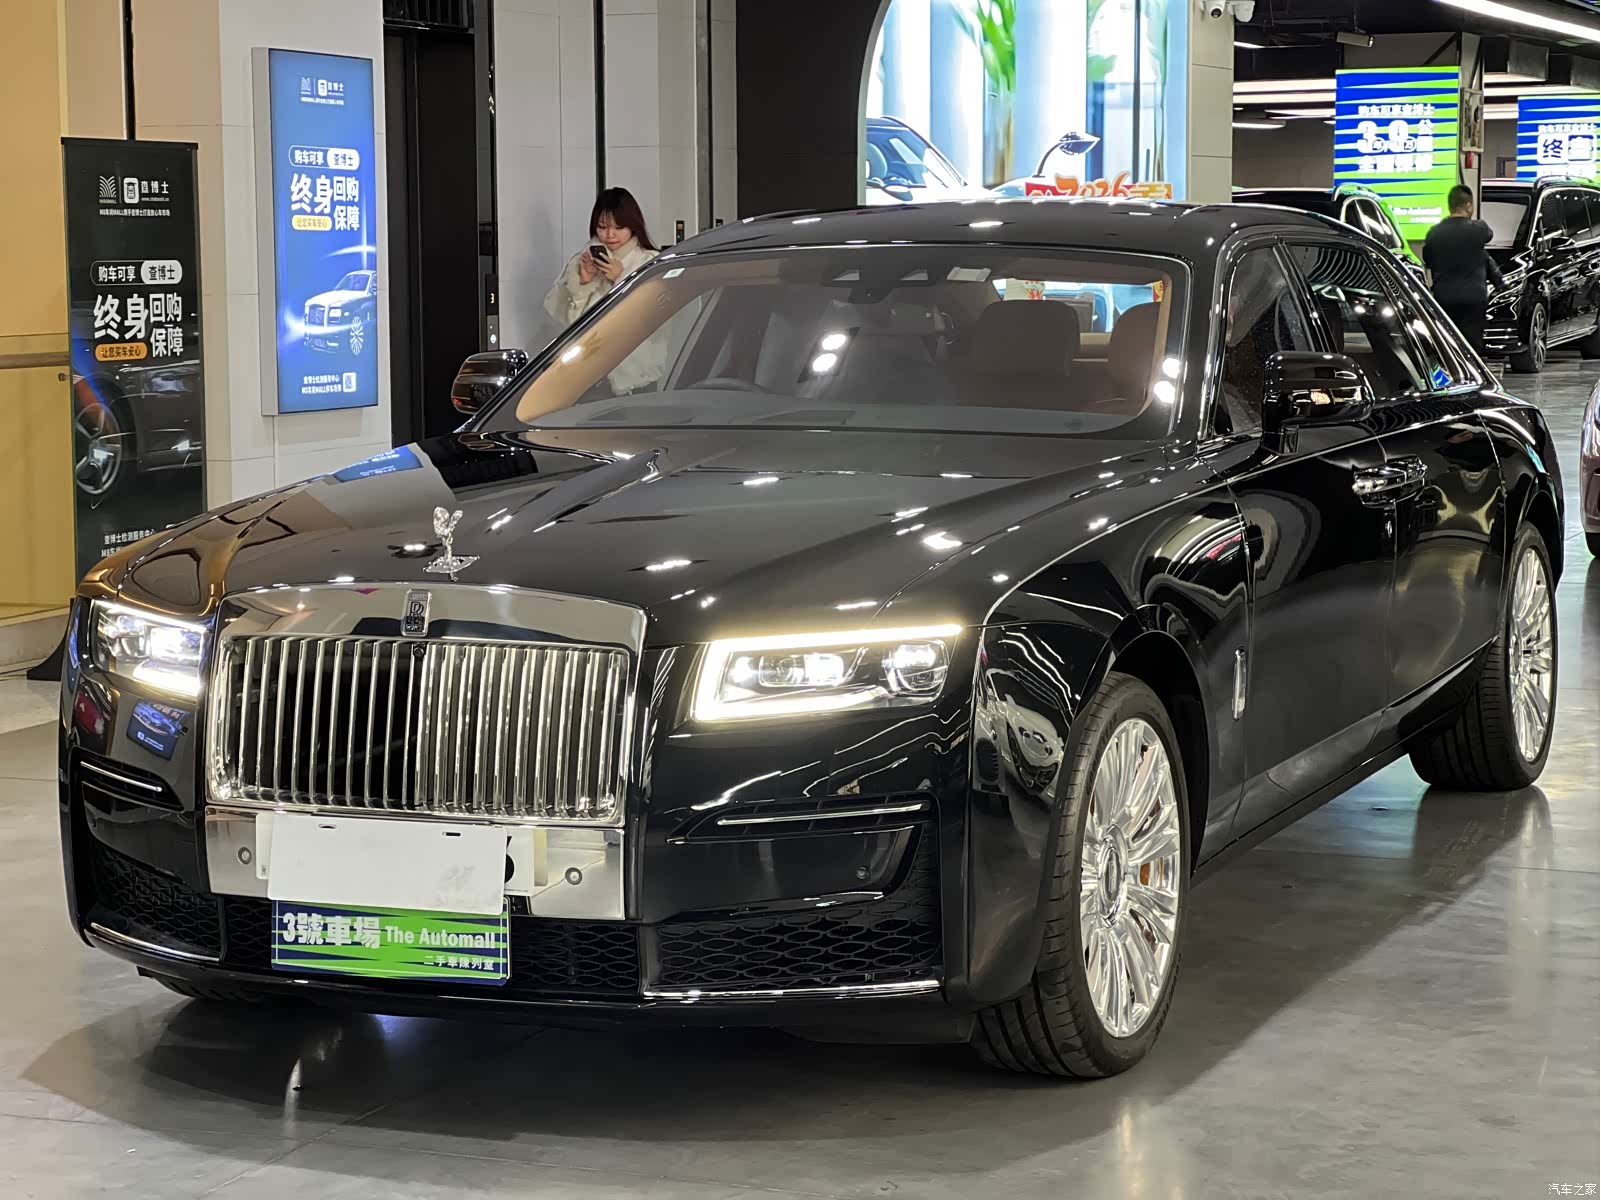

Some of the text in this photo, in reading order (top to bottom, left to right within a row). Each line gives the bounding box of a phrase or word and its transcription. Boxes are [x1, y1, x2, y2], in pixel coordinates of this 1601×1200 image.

[295, 150, 325, 166] 购车可享
[333, 154, 354, 167] 查博士
[290, 173, 333, 214] 终身
[333, 176, 359, 203] 回购
[333, 205, 360, 231] 保障
[98, 265, 136, 282] 购车可享
[149, 265, 175, 281] 查博士
[93, 293, 149, 340] 终身
[149, 292, 182, 323] 回购
[101, 346, 142, 359] 让您买车安心
[150, 326, 184, 358] 保障
[282, 912, 496, 950] 3號車場 The Automall
[423, 955, 495, 971] 二手車陳列室
